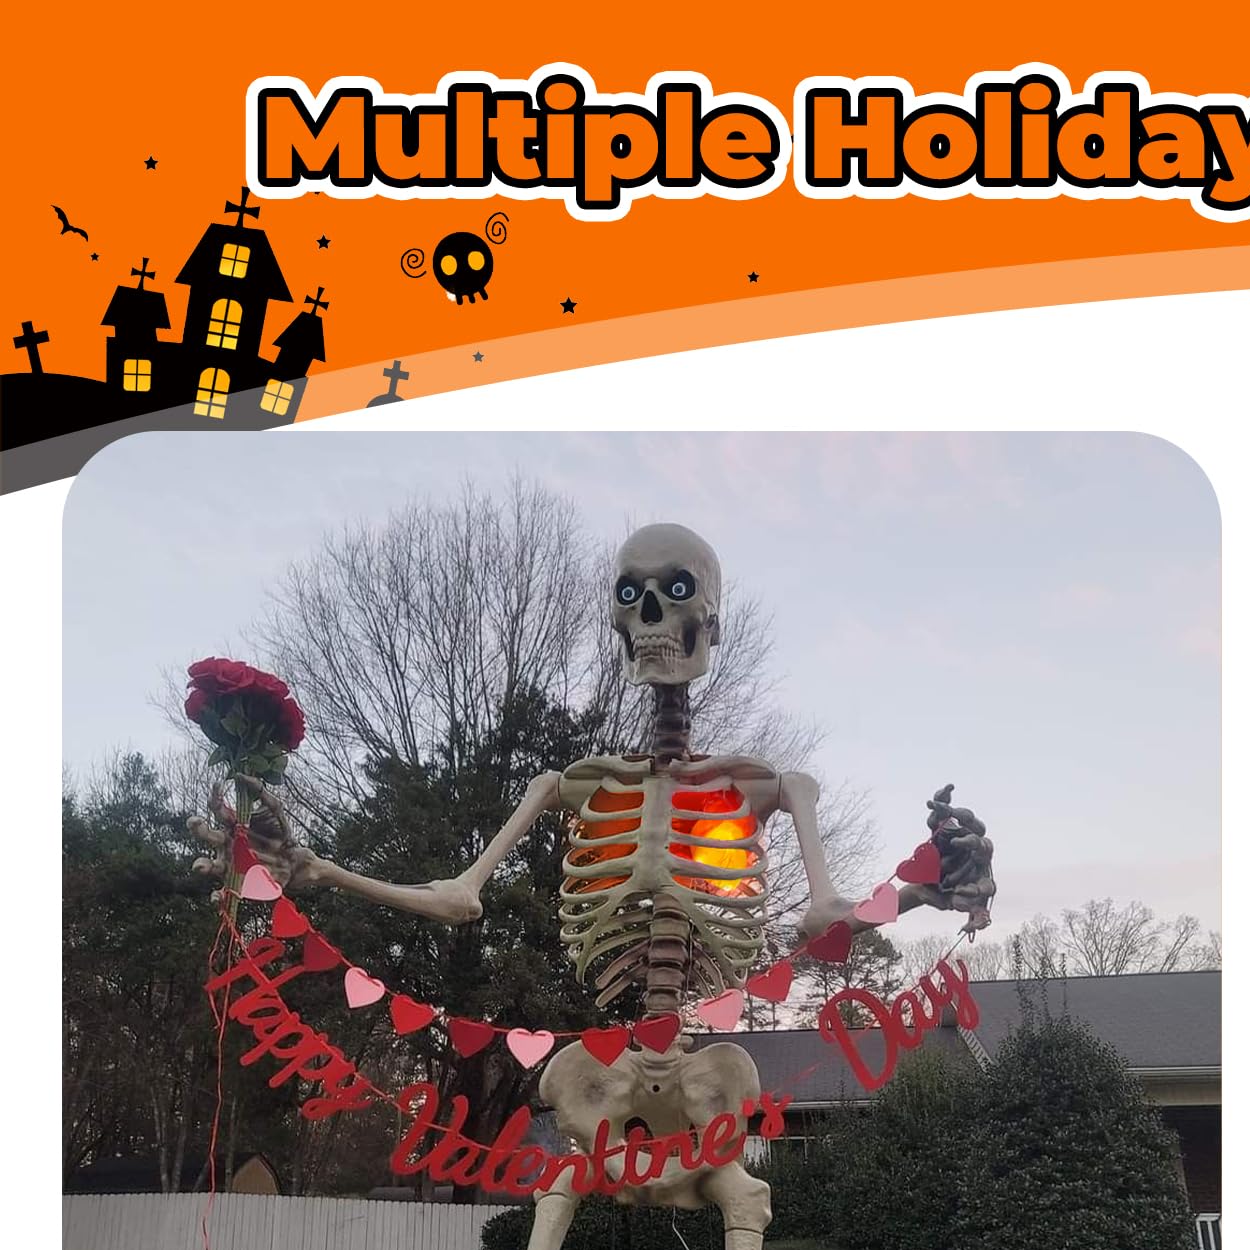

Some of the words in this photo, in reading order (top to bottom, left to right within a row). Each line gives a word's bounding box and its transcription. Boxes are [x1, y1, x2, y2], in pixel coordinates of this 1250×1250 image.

[204, 937, 372, 1120] Happy
[390, 1082, 794, 1197] Valentine's
[819, 959, 980, 1091] Day
